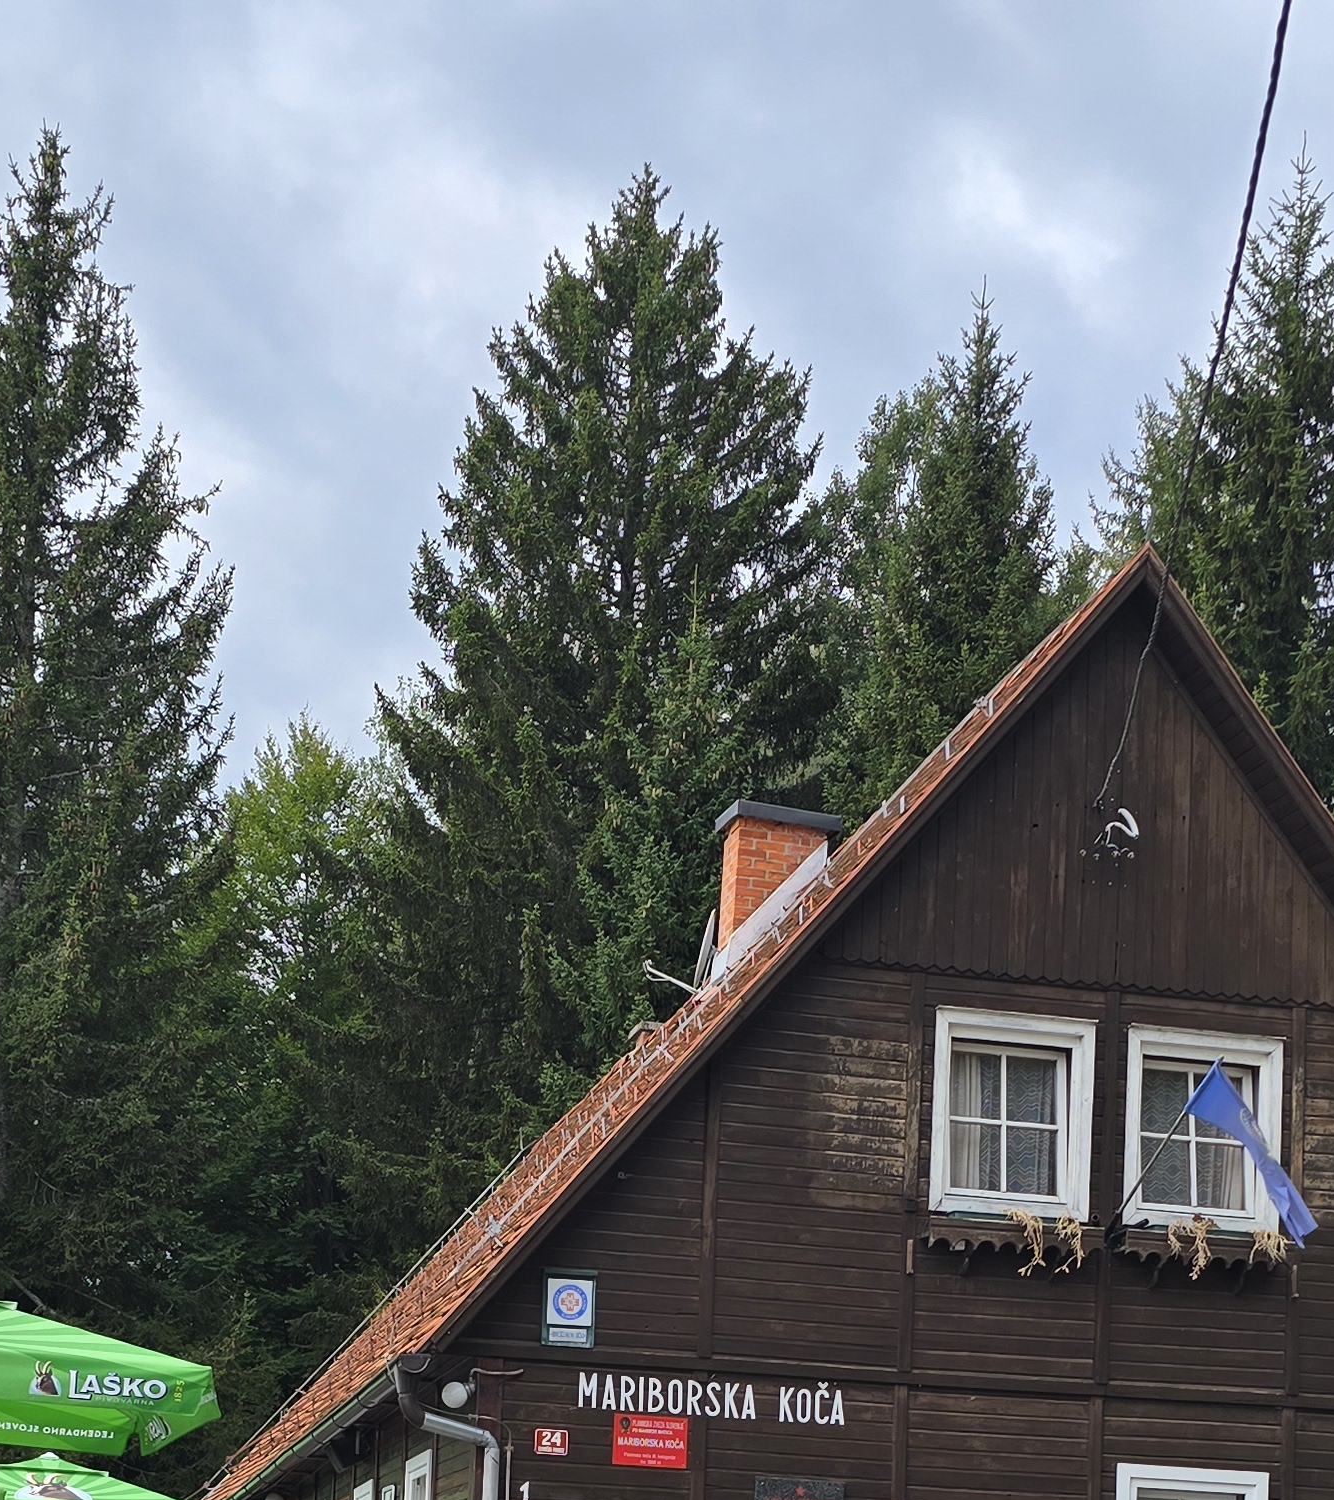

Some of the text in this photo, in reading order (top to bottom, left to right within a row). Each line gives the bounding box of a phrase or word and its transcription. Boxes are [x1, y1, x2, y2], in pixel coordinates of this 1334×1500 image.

[68, 1369, 168, 1400] LAŠKO
[578, 1372, 846, 1426] MARIBORSKA KOČA
[541, 1431, 562, 1447] 24
[617, 1436, 685, 1450] MARIBORSKA KOČA
